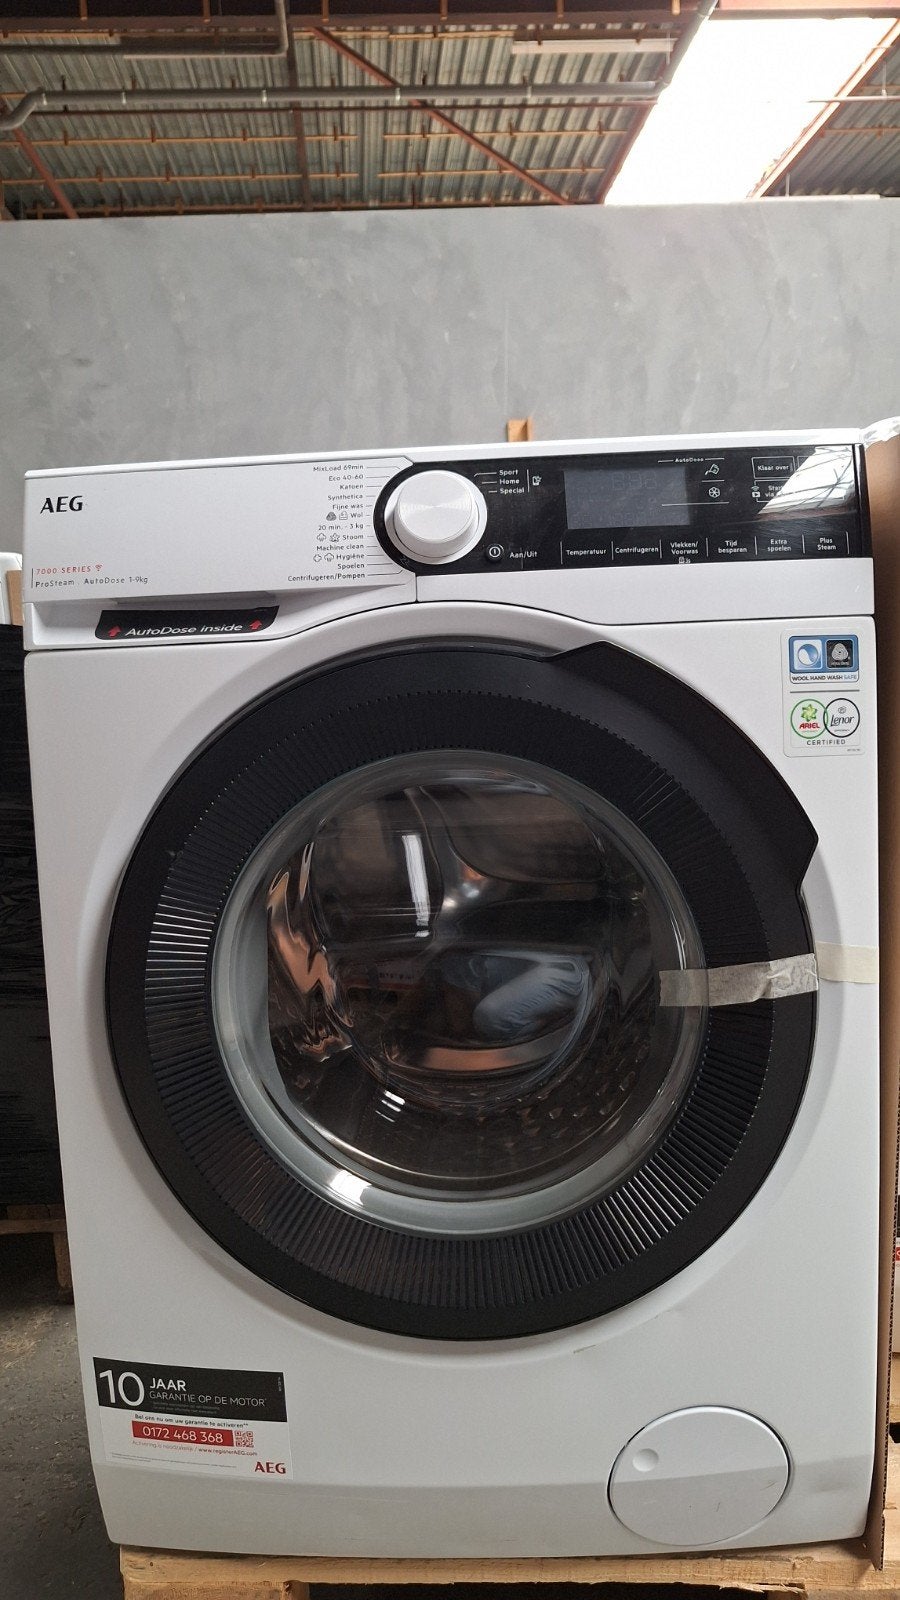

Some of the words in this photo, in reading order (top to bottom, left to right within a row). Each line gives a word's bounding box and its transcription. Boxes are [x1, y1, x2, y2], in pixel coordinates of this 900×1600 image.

[499, 487, 525, 495] Special
[327, 493, 363, 501] Synthetica
[40, 495, 83, 514] AEG
[332, 503, 349, 511] Fijne
[355, 522, 364, 530] kg
[509, 550, 538, 559] Aan/Uit
[566, 548, 607, 556] Temperatuur
[615, 546, 659, 554] Centrifugeren
[336, 553, 365, 561] Hygiëne
[36, 567, 57, 575] 7000
[61, 565, 91, 574] SERIES
[337, 563, 365, 571] Spoelen
[35, 579, 75, 588] ProSteam
[84, 576, 125, 585] AutoDose
[129, 576, 148, 585] 1-9kg
[287, 572, 366, 582] Centrifugeren/Pompen
[124, 626, 197, 636] AutoDose
[200, 624, 243, 633] inside
[830, 714, 855, 727] Lenor
[99, 1369, 145, 1407] 10
[150, 1377, 187, 1391] JAAR
[149, 1390, 195, 1403] GARANTIE
[198, 1395, 212, 1404] OP
[214, 1396, 228, 1405] DE
[142, 1426, 169, 1439] 0172
[173, 1429, 197, 1441] 468
[200, 1431, 224, 1443] 368
[254, 1461, 287, 1475] AEG
